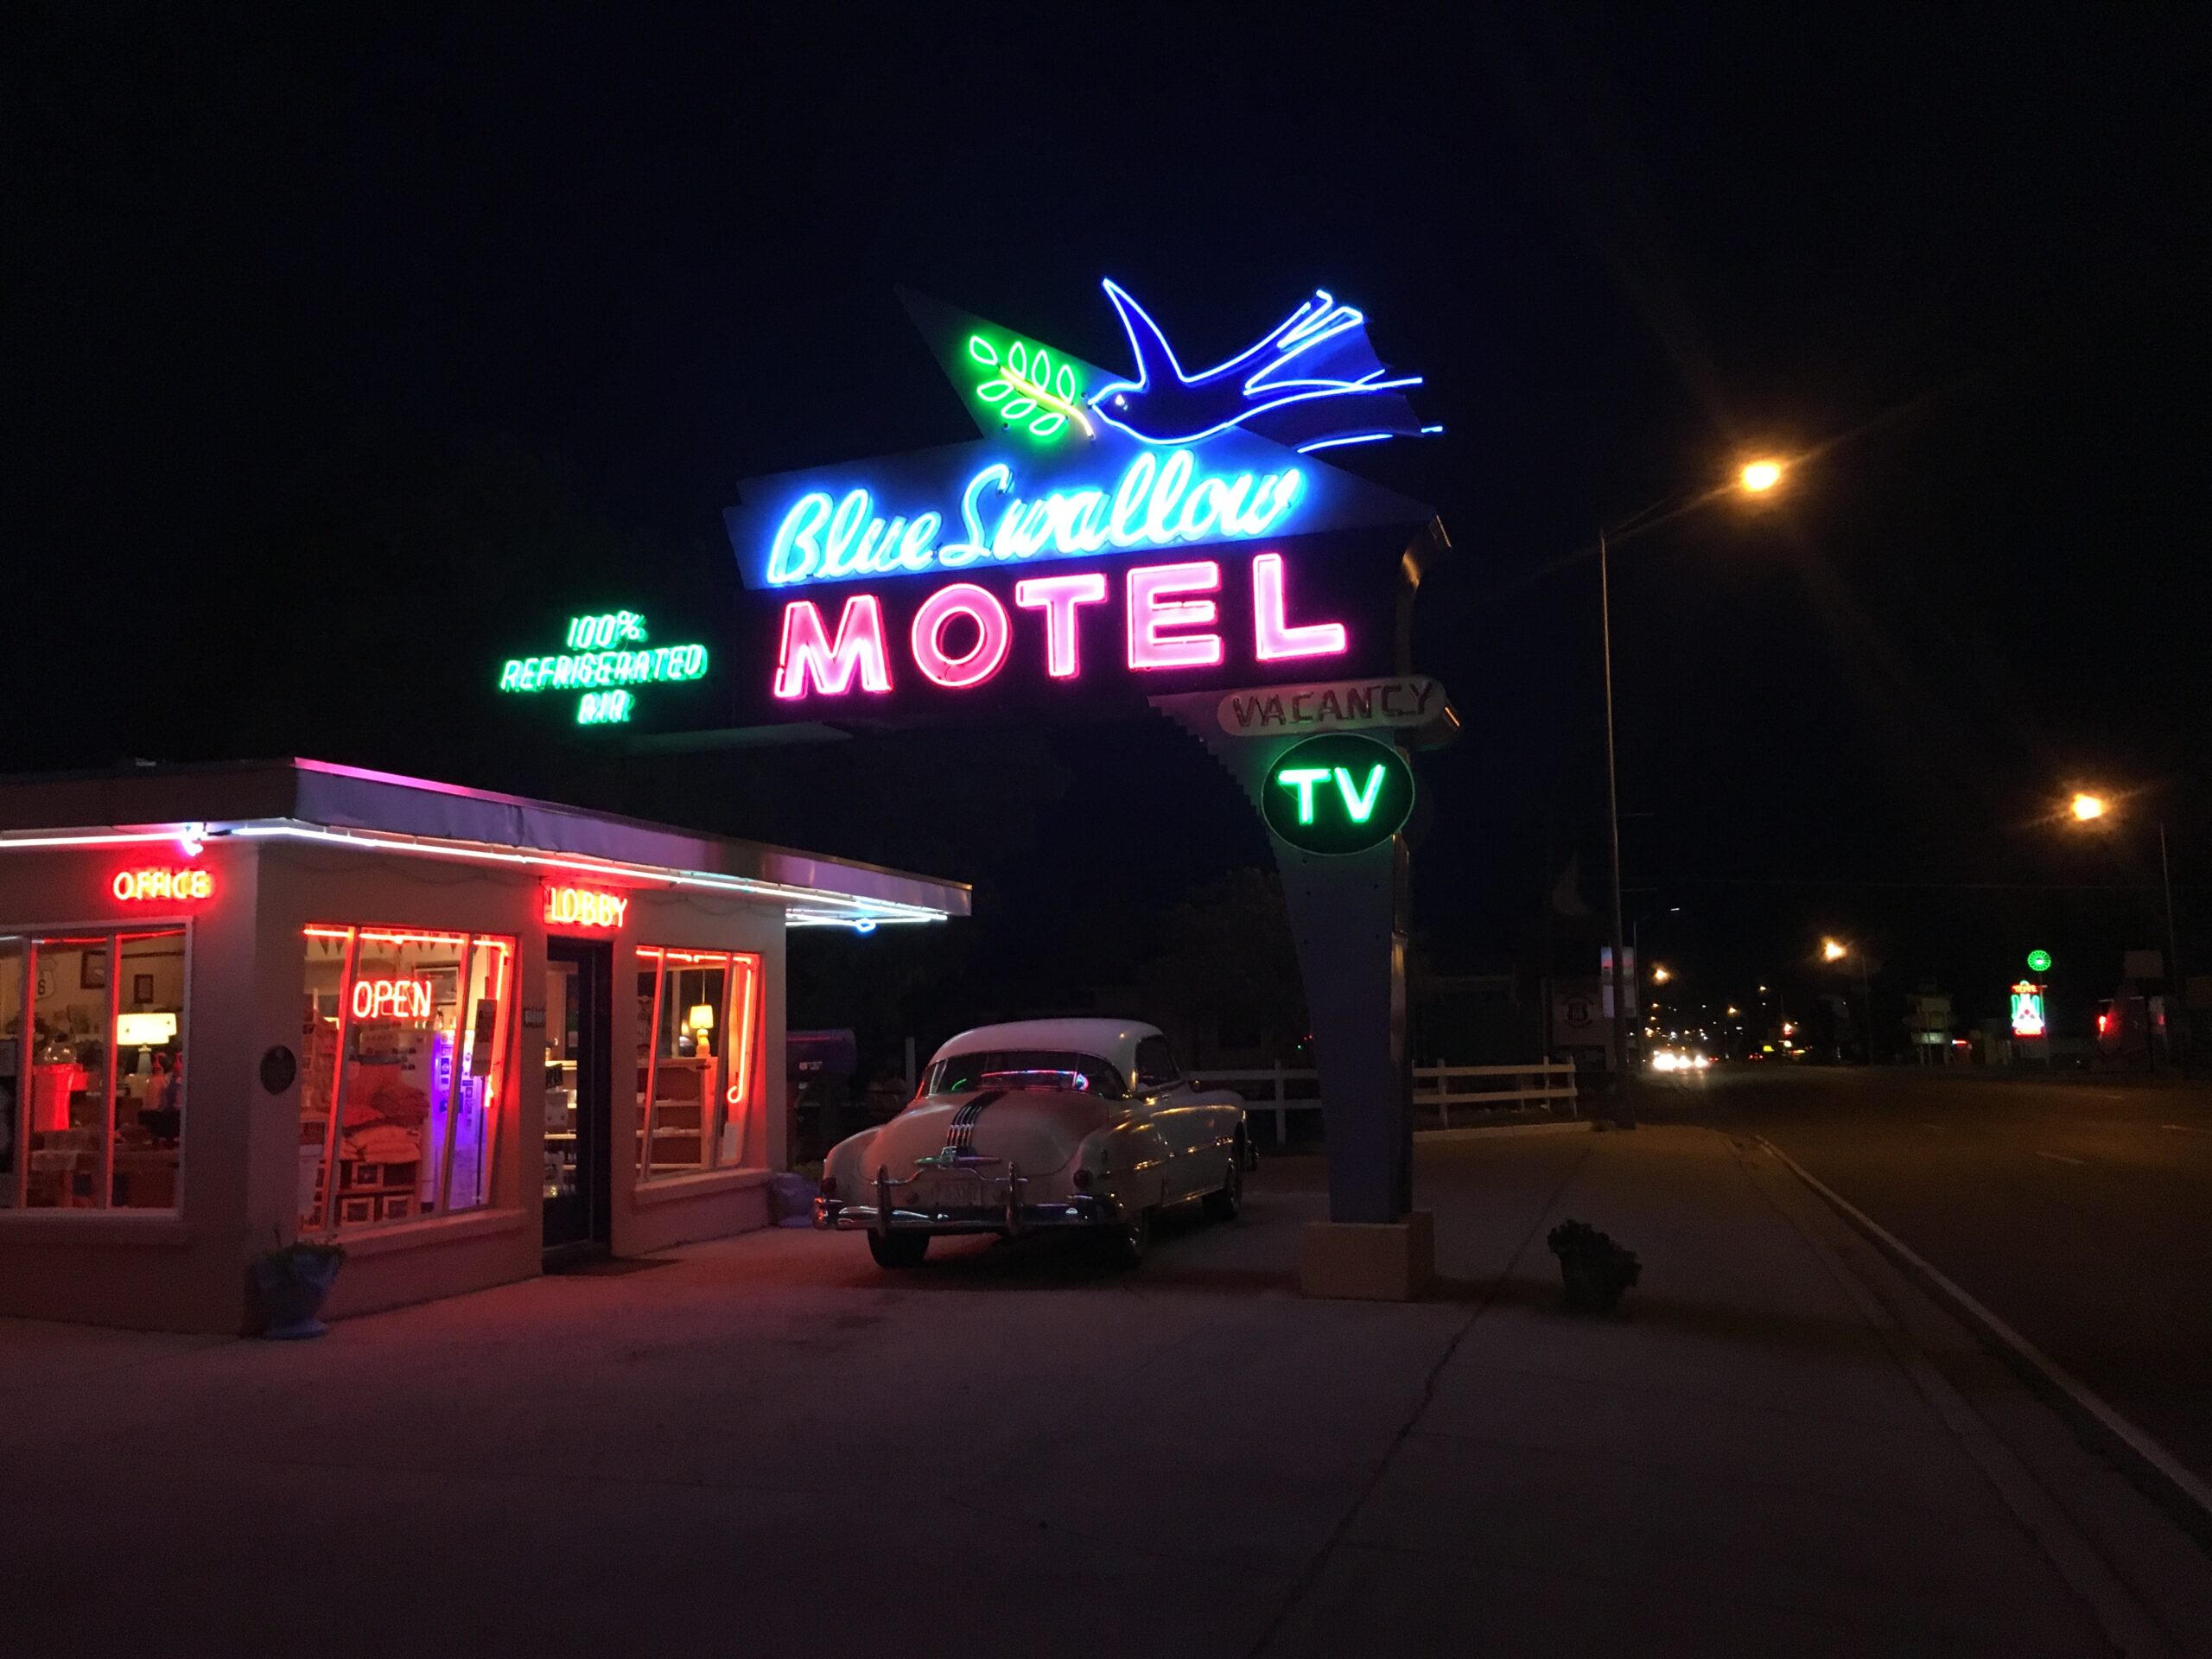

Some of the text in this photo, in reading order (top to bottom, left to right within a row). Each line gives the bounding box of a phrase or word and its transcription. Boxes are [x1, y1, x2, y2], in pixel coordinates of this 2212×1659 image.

[766, 447, 1303, 586] Blue Swallow
[567, 610, 647, 650] 100%
[773, 551, 1349, 700] MOTEL
[500, 644, 708, 692] REFRIGERATED
[577, 689, 635, 725] AIR
[1231, 683, 1434, 728] VACANCY
[1277, 764, 1387, 825] TV
[113, 870, 211, 900] OFFICE
[550, 887, 628, 929] LOBBY
[353, 980, 432, 1018] OPEN
